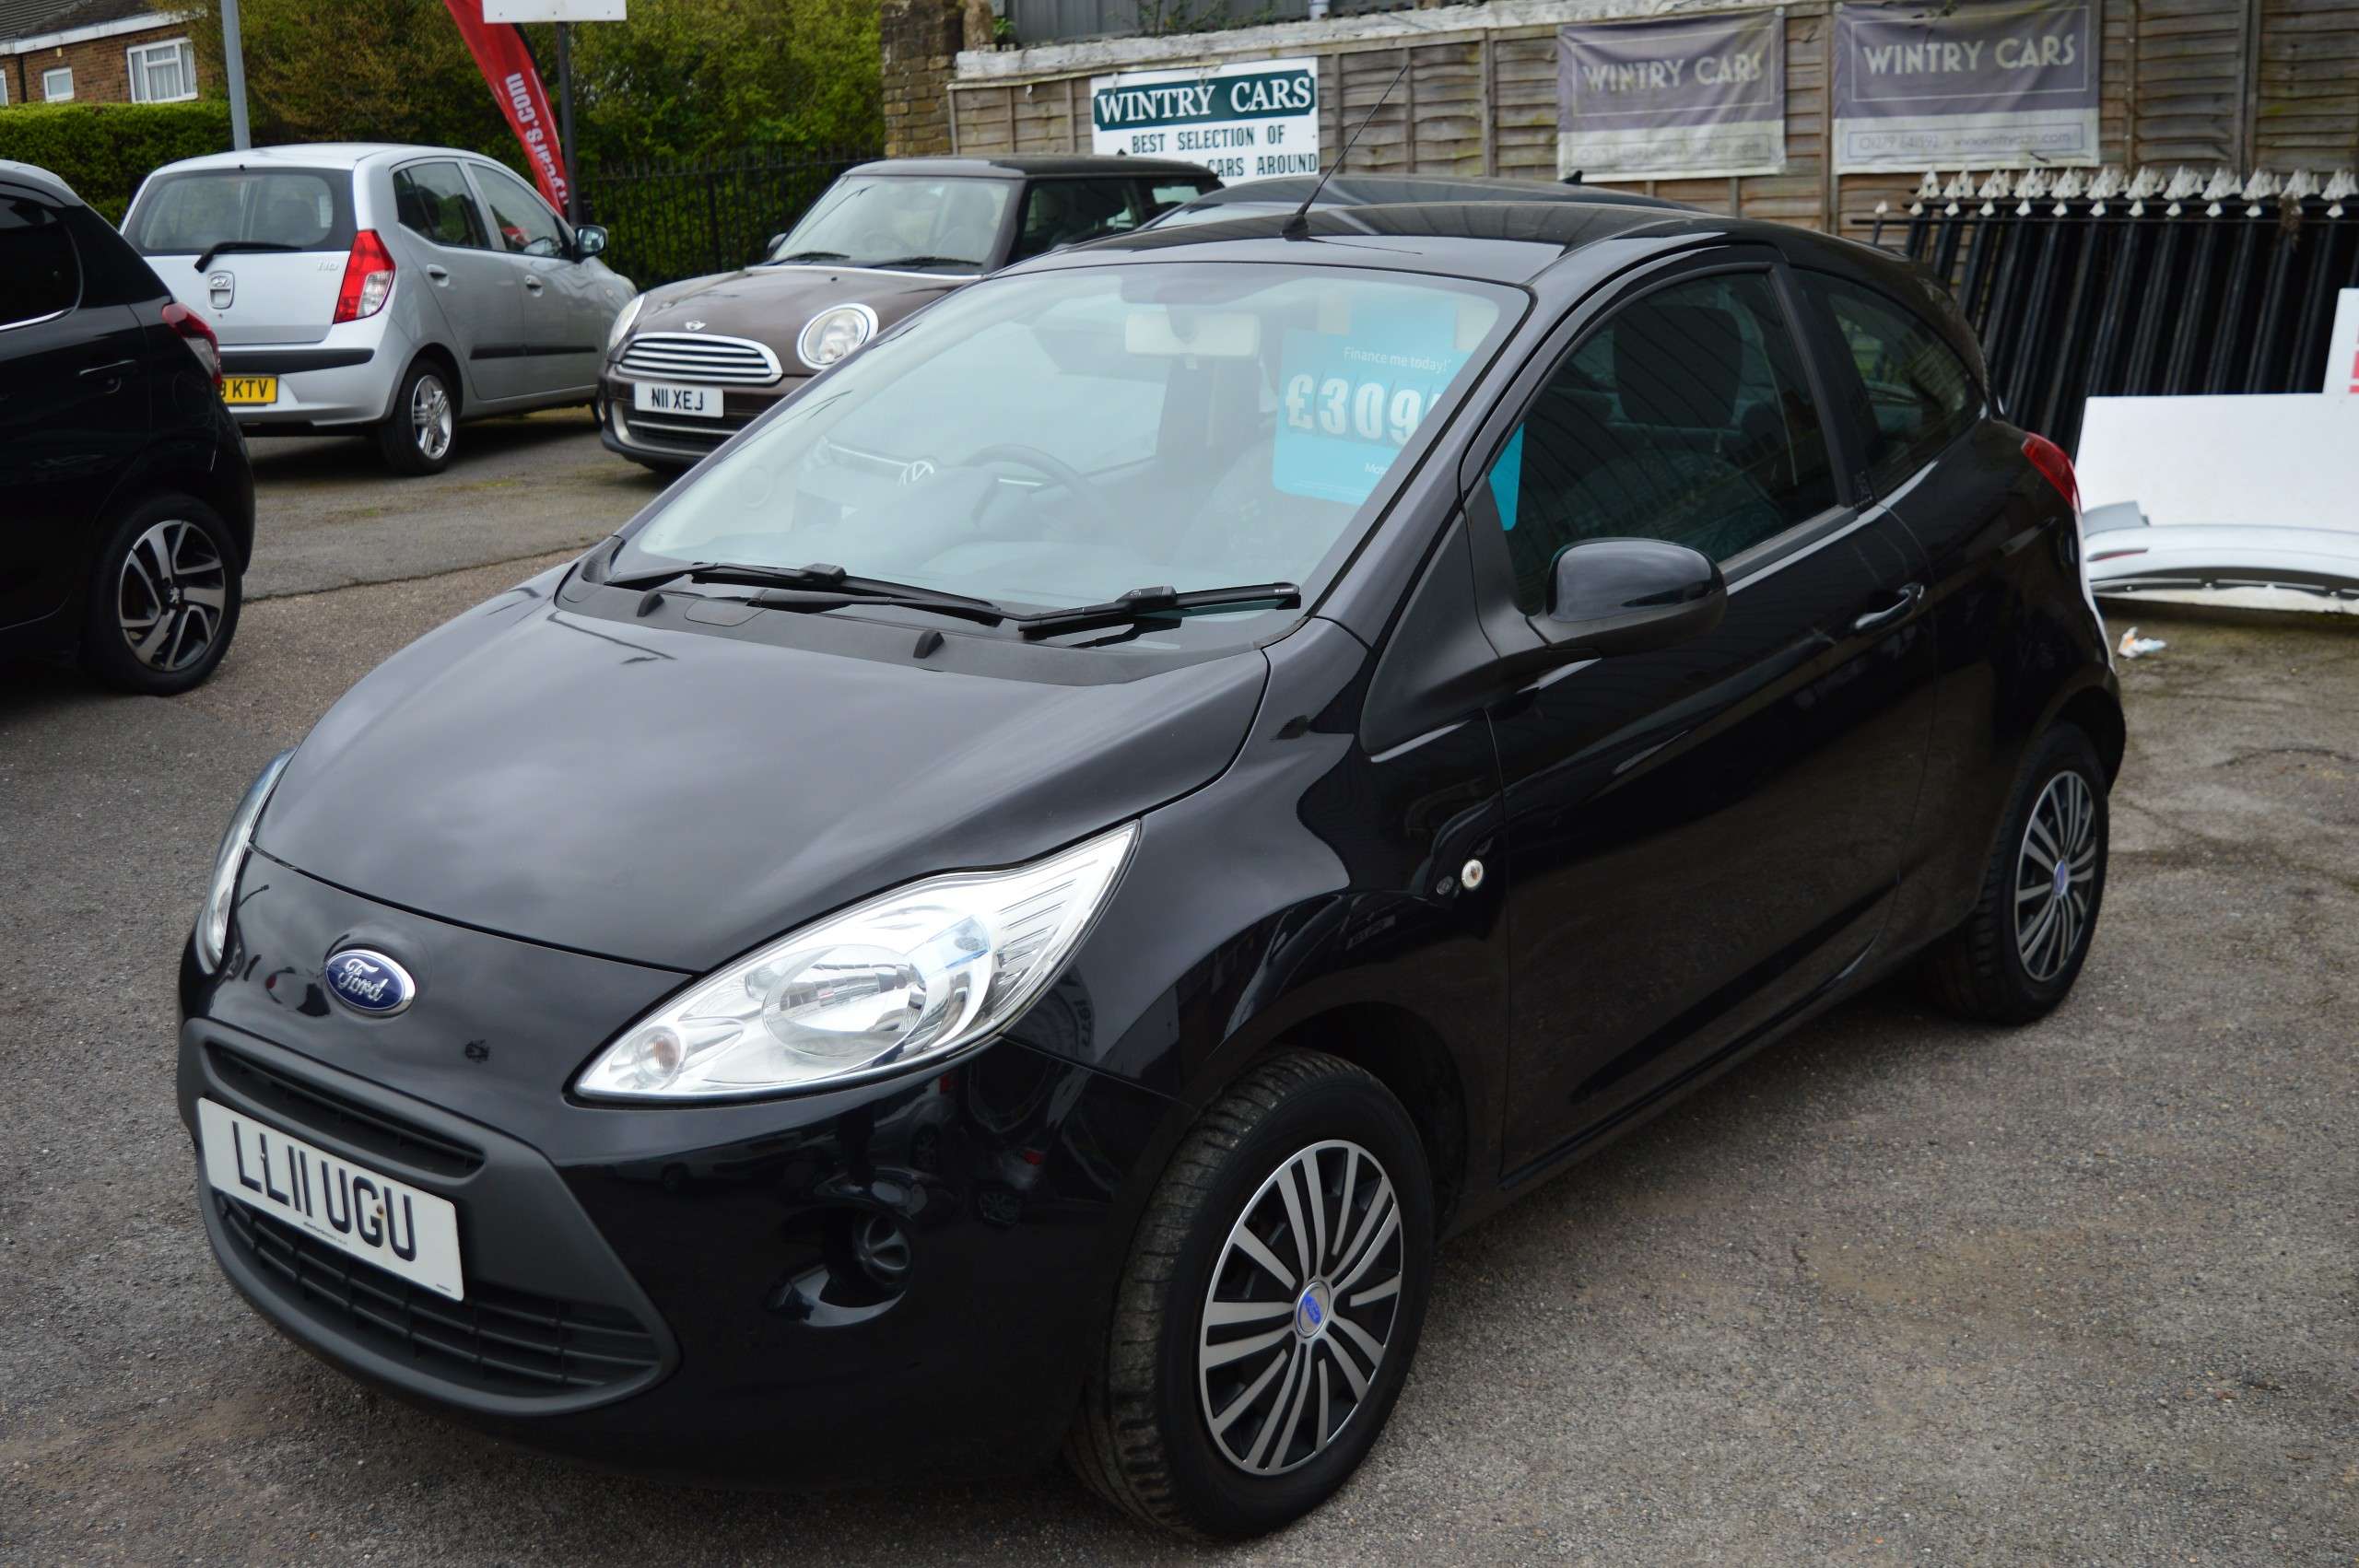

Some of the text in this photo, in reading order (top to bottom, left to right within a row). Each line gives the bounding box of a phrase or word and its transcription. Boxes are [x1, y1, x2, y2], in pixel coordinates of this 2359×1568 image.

[1582, 52, 1763, 92] WINTRY CARS
[1863, 34, 2075, 76] WINTRY CARS
[1097, 76, 1312, 123] WINTRY CARS
[1132, 124, 1285, 154] BEST SELECTION OF
[1207, 153, 1318, 178] CARS AROUND
[1390, 355, 1408, 368] me
[232, 380, 268, 398] KTV
[674, 390, 704, 411] XEJ
[1285, 373, 1442, 447] £309
[337, 958, 389, 1002] Ford
[232, 1120, 417, 1262] LL11 UGU
